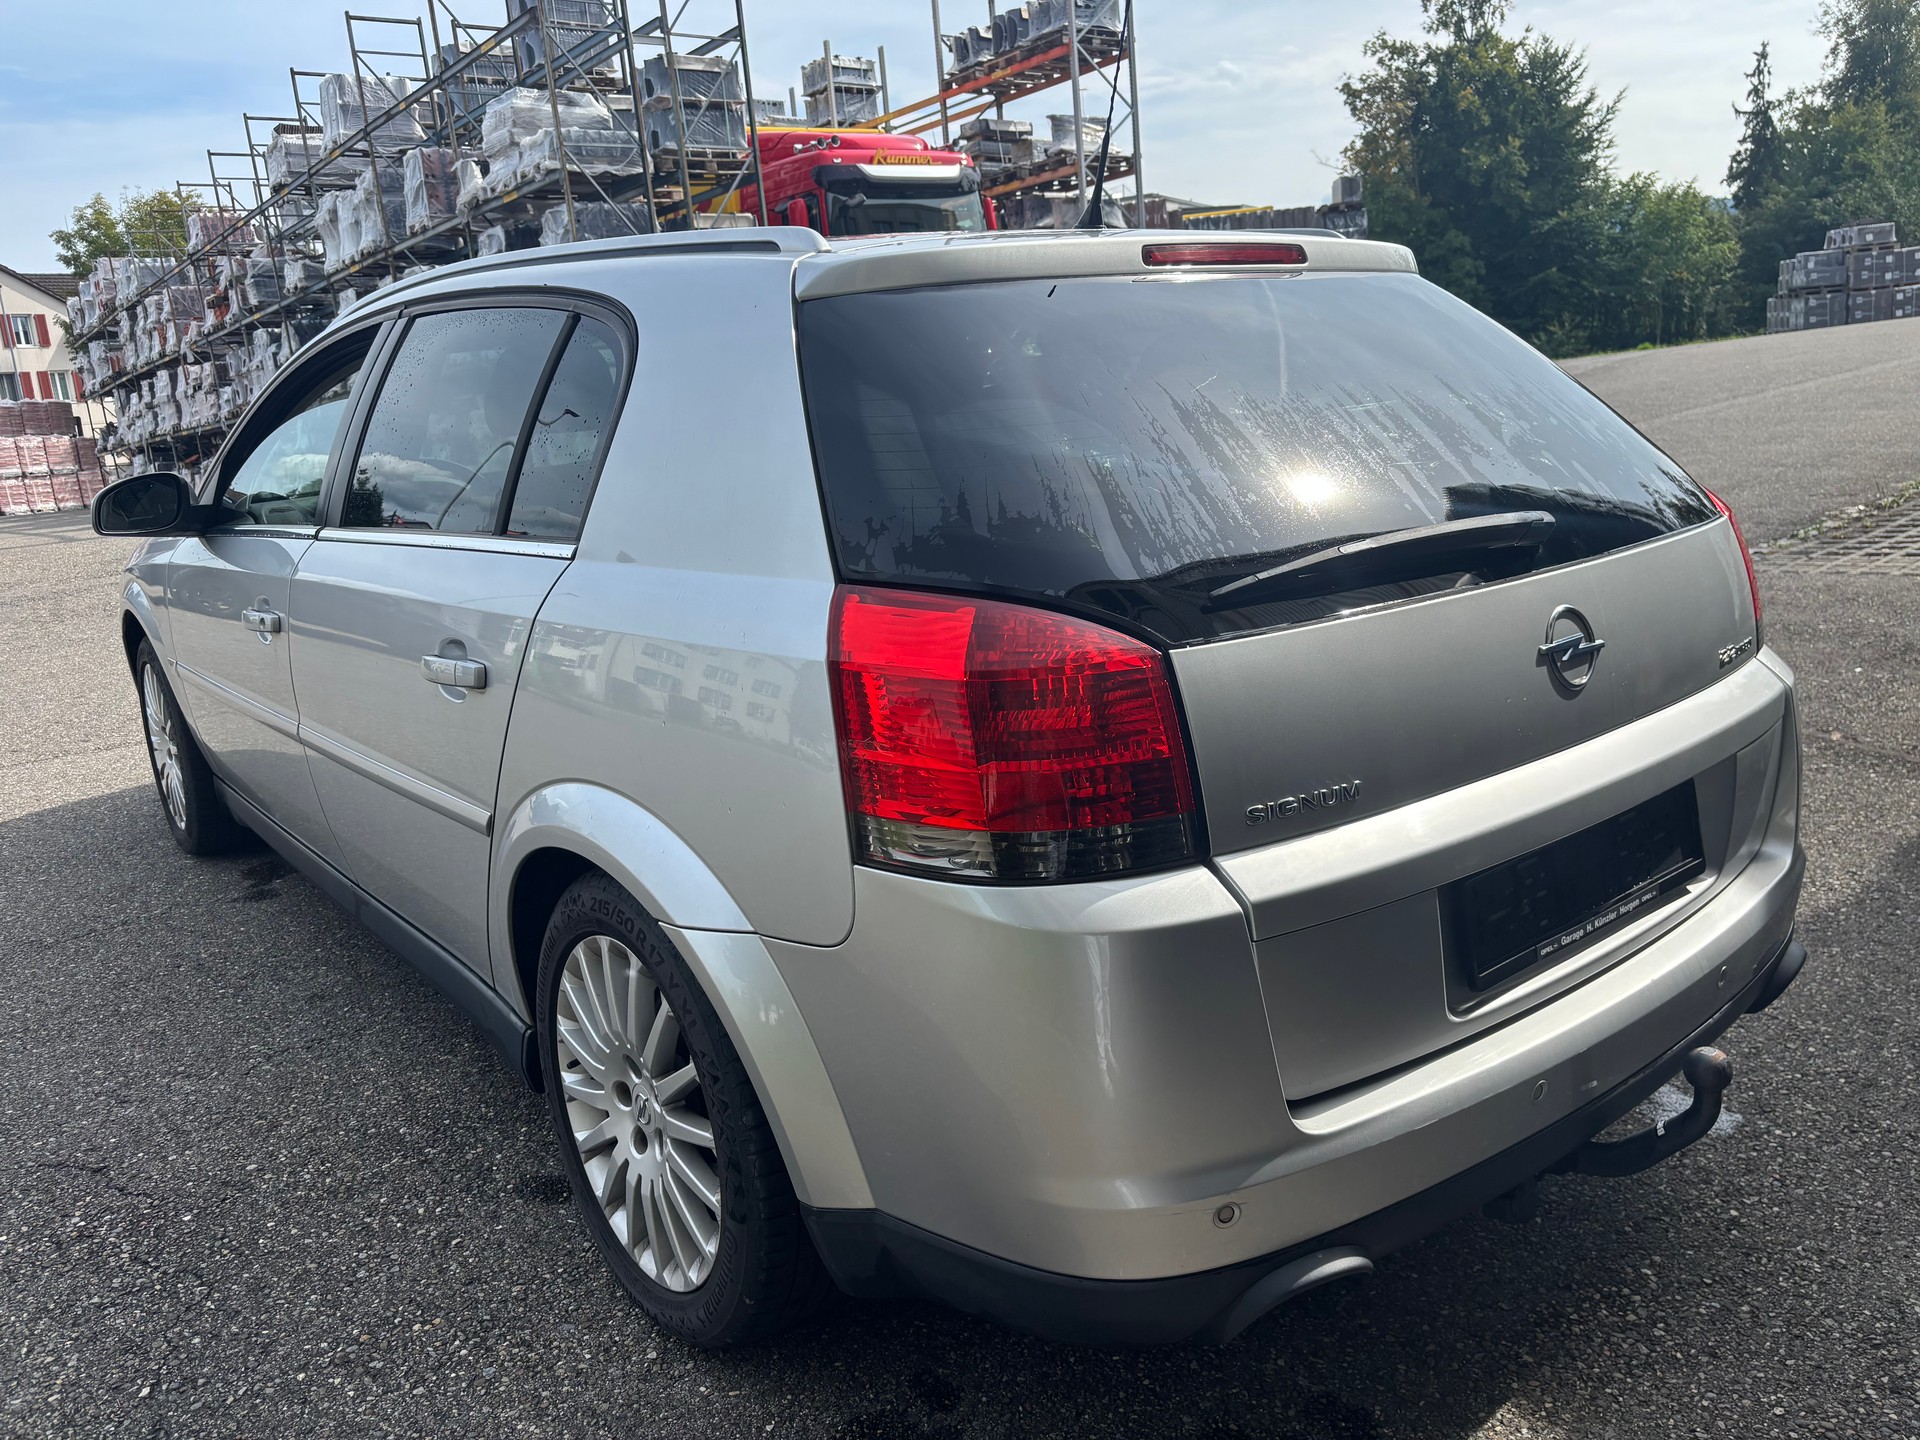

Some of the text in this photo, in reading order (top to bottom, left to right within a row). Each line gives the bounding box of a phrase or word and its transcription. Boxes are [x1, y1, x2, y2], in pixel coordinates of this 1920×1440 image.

[873, 148, 942, 165] Kummer
[1245, 779, 1362, 826] SIGNUM
[589, 896, 636, 935] 215/50
[635, 928, 647, 949] R
[648, 943, 666, 968] 17
[1540, 892, 1653, 956] OPEL Garage H. Künzler Horgen OPEL
